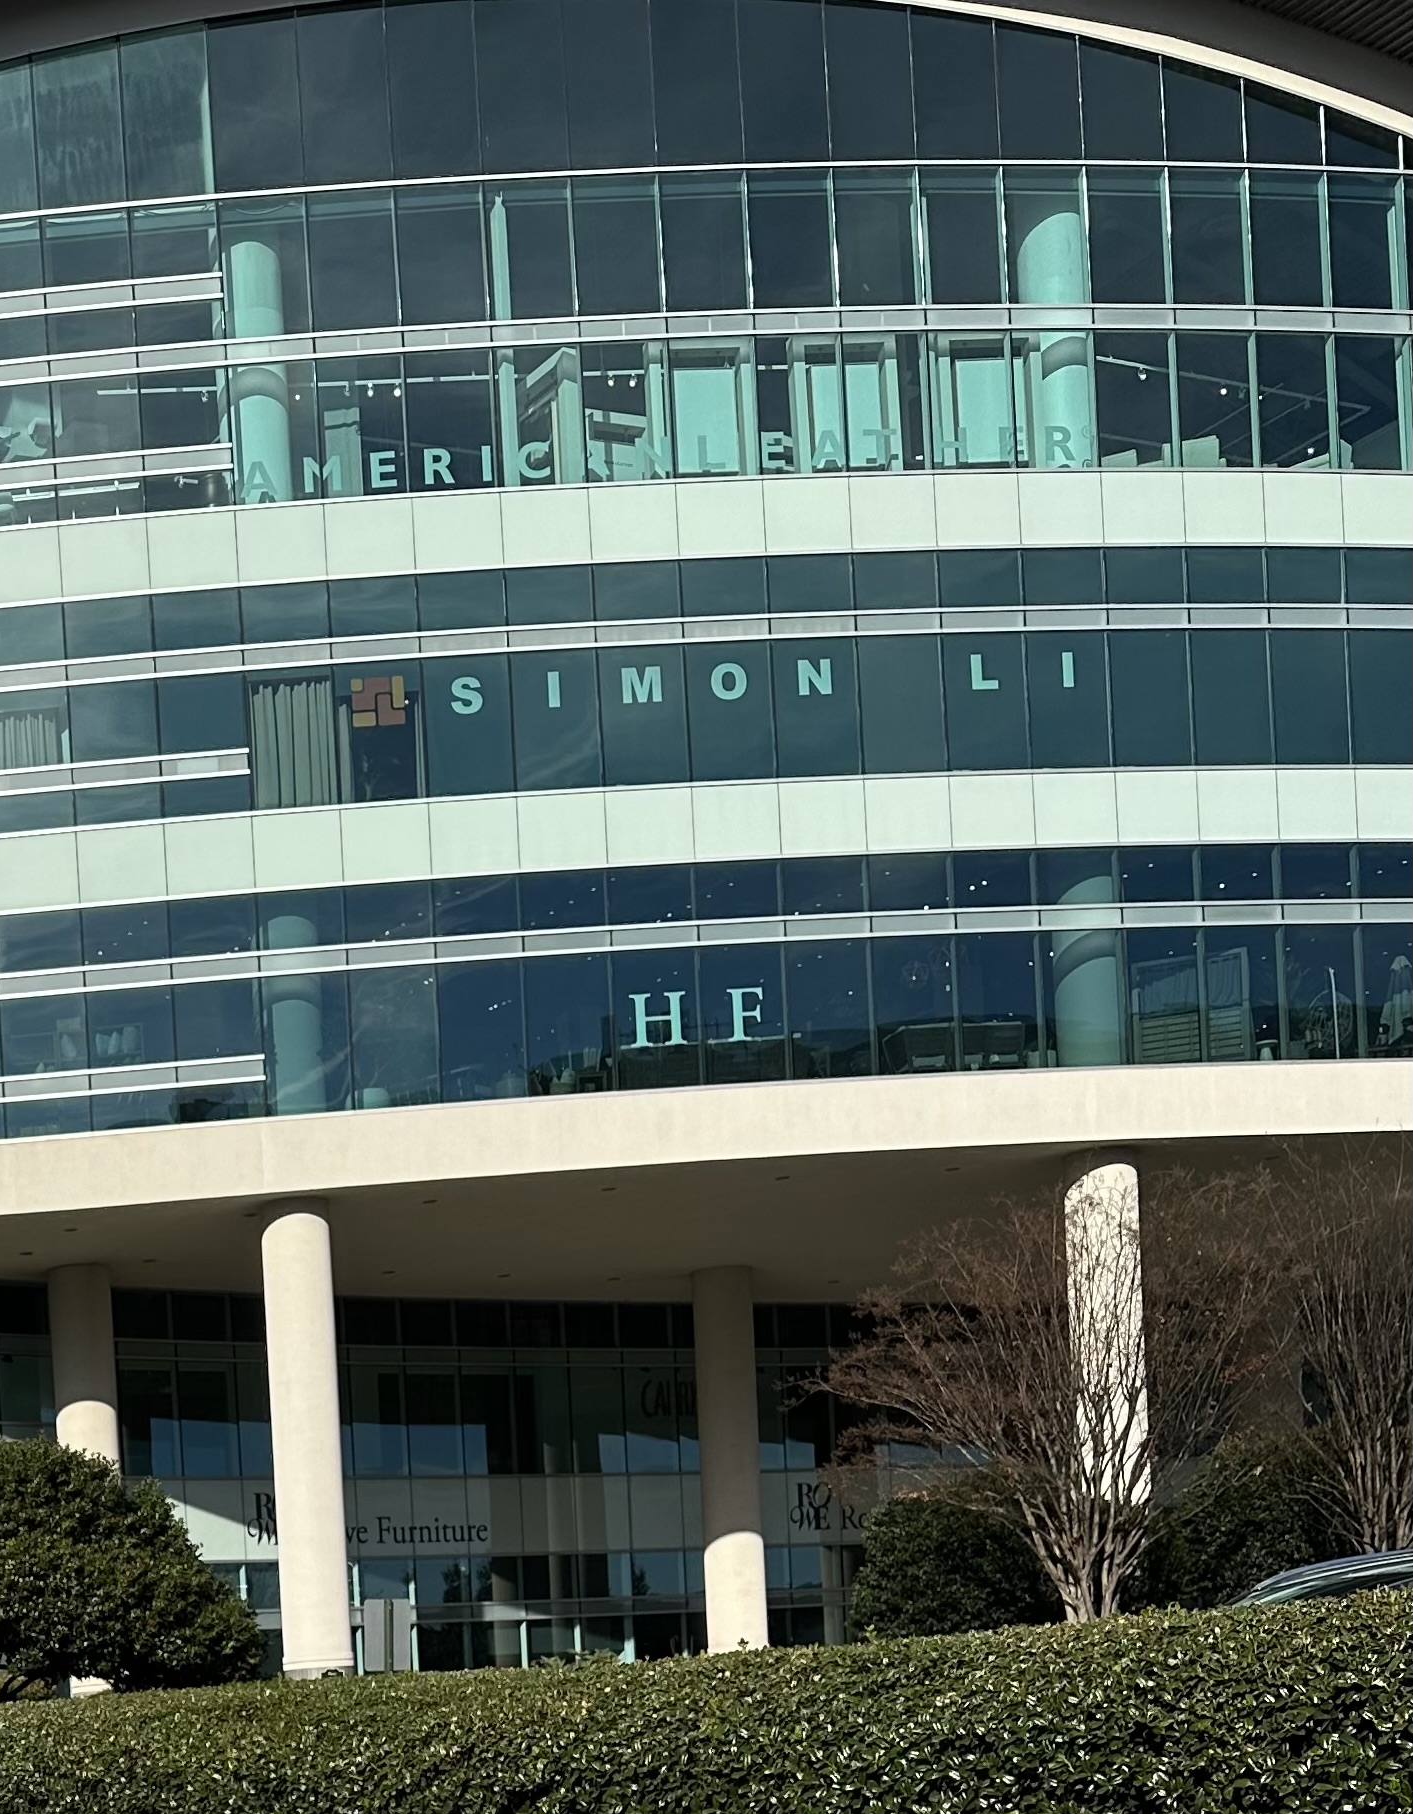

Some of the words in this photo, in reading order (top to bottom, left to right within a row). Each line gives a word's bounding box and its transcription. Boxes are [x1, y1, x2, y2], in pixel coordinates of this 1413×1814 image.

[449, 657, 834, 715] SIMON
[970, 651, 1076, 692] LI
[375, 1515, 489, 1545] Furniture
